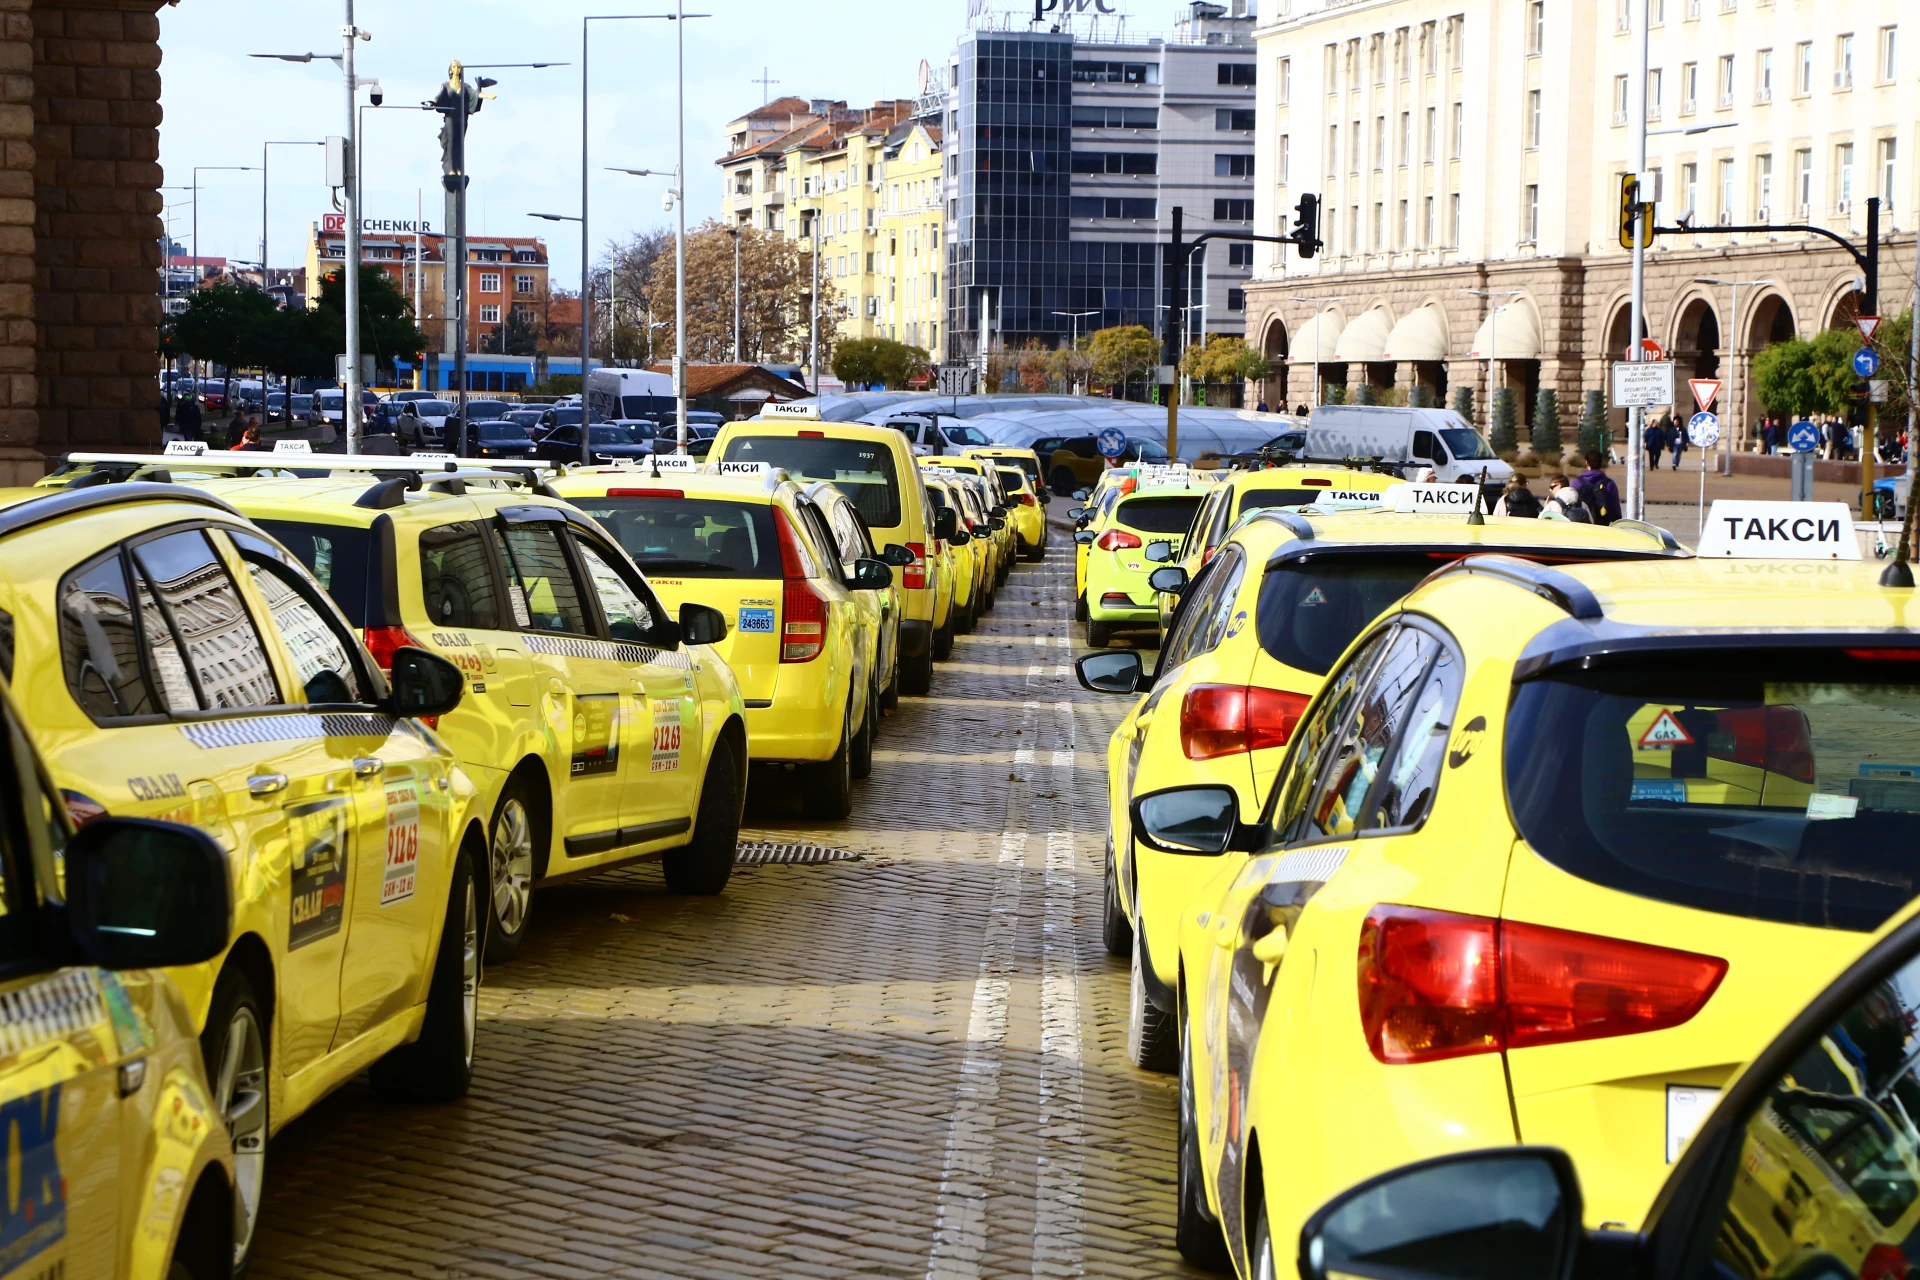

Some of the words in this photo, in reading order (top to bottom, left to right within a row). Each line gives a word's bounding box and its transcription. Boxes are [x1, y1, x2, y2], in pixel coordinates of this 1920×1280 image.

[774, 405, 808, 414] ТАКСИ
[172, 444, 204, 452] ТАКСИ
[650, 460, 687, 468] ТАКСИ
[1330, 491, 1380, 501] ТАКСИ
[1413, 490, 1473, 504] ТАКСИ
[1723, 517, 1840, 542] ТАКСИ
[742, 618, 770, 629] 243663
[1655, 731, 1677, 741] GAS
